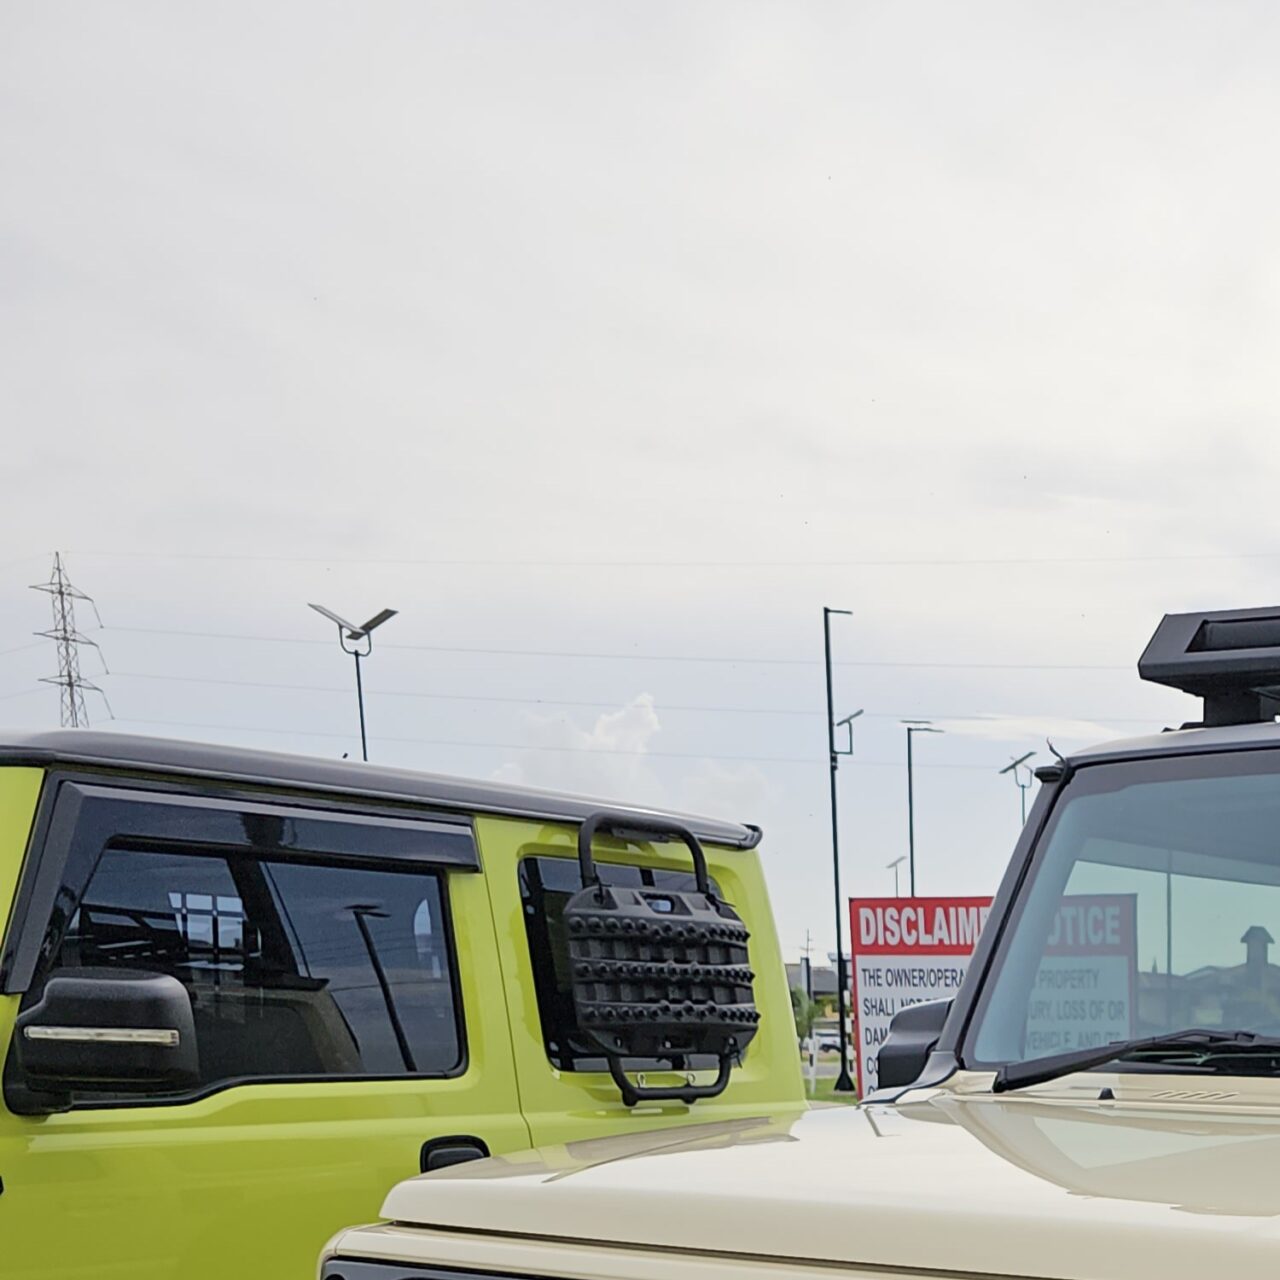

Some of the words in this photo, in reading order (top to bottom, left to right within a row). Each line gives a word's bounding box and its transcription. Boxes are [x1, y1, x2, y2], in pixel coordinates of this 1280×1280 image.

[862, 968, 882, 988] THE
[1039, 968, 1100, 990] PROPERTY
[1057, 1000, 1086, 1021] LOSS
[1089, 1000, 1105, 1020] OF
[1108, 1000, 1126, 1020] OR
